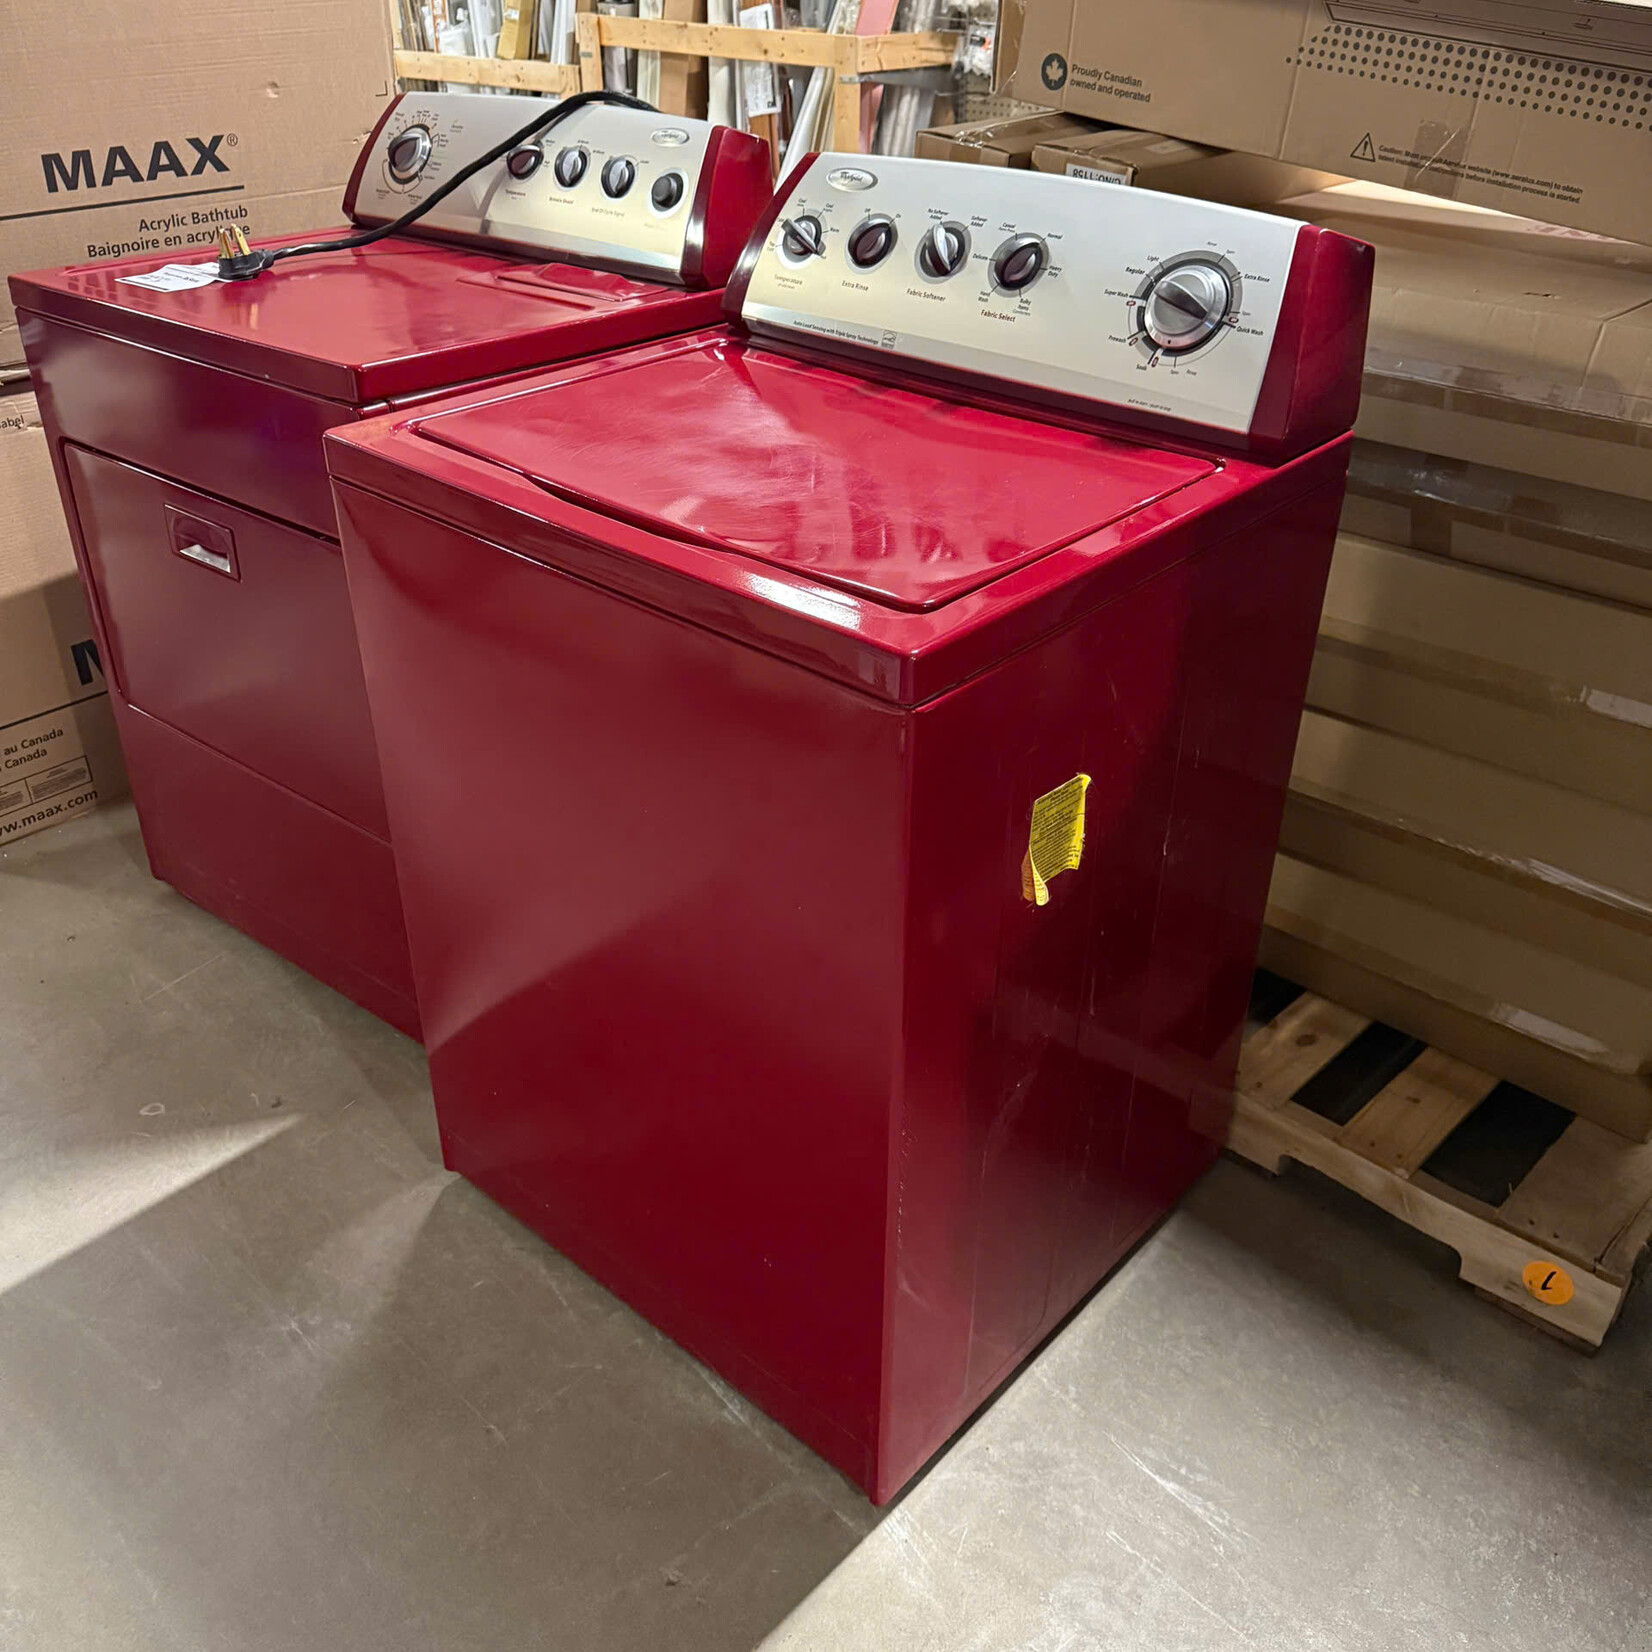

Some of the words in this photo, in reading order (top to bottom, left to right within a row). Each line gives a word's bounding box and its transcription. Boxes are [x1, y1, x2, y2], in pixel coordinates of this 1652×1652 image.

[1072, 64, 1102, 80] Proudly
[1103, 71, 1142, 87] Canadian
[1070, 79, 1096, 91] owned
[1097, 84, 1112, 94] and
[1114, 88, 1150, 103] operated
[1522, 186, 1548, 197] process
[1562, 184, 1583, 194] obtain
[139, 215, 187, 232] Acrylic
[191, 205, 248, 225] Bathtub
[87, 237, 160, 258] Baignoire
[164, 233, 182, 247] en
[1125, 266, 1145, 275] Regular
[841, 279, 855, 289] Extra
[855, 282, 869, 291] Rinse
[1244, 273, 1257, 281] Extra
[1257, 275, 1270, 283] Rinse
[906, 288, 922, 297] Fabric
[923, 291, 946, 302] Softener
[981, 309, 998, 320] Fabric
[998, 312, 1016, 323] Select
[1236, 325, 1250, 334] Quick
[1250, 328, 1264, 336] Wash
[1108, 335, 1126, 343] Prewash
[0, 414, 24, 429] abel
[4, 744, 18, 756] au
[21, 729, 64, 749] Canada
[4, 748, 48, 769] Canada
